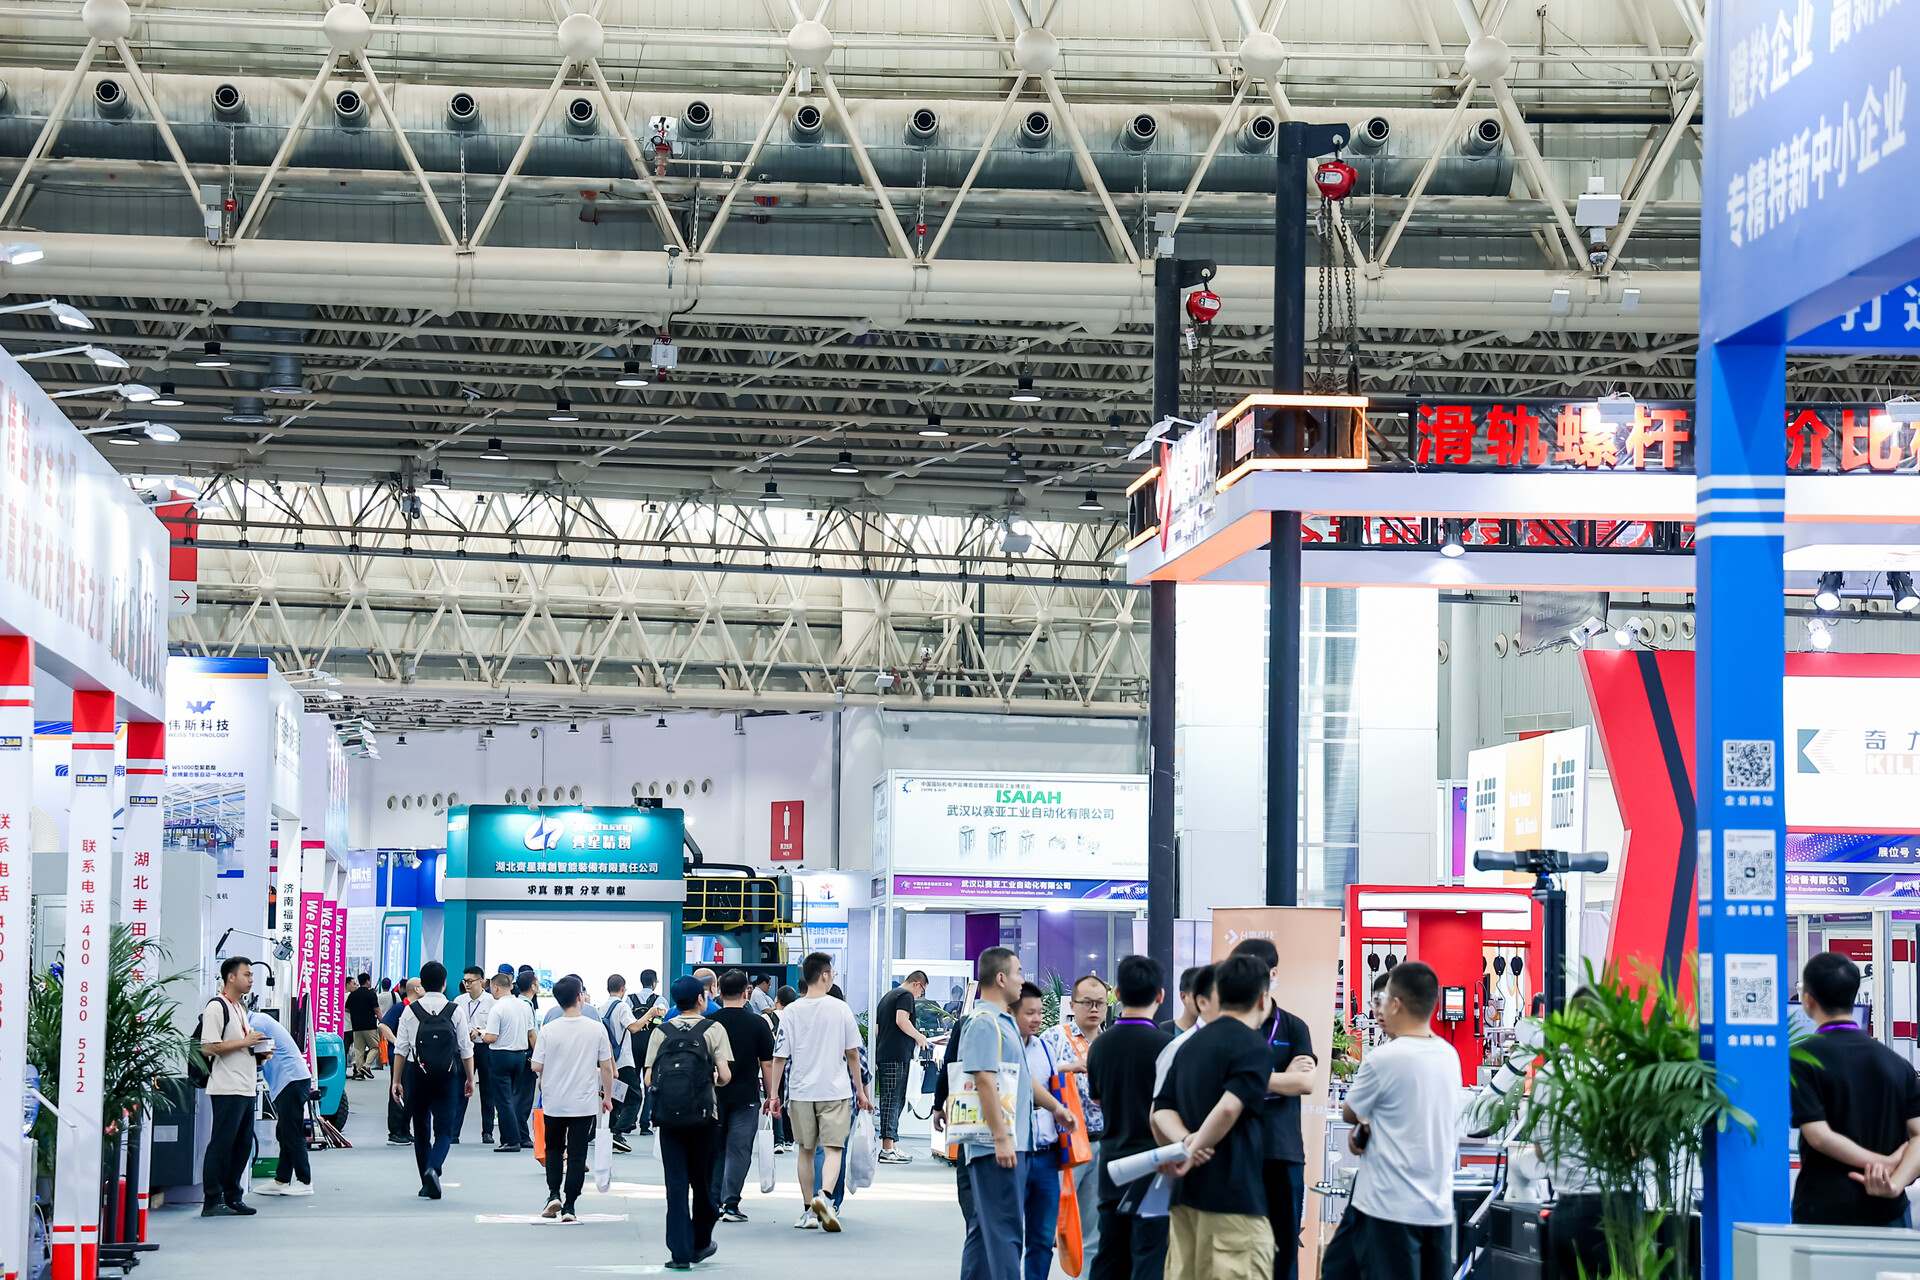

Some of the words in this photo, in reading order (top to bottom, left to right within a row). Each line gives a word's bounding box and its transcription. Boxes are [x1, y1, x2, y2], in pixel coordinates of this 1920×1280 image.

[1726, 65, 1906, 248] 专精特新中小企业
[1417, 404, 1691, 470] 滑轨螺杆
[1786, 408, 1920, 472] 价比
[168, 719, 230, 731] 伟斯科技
[946, 804, 1115, 820] 武汉以赛亚工业自动化有限公司
[996, 789, 1062, 804] ISAIAH
[80, 839, 97, 914] 联系电话
[306, 900, 318, 921] We
[322, 907, 333, 927] We
[335, 914, 344, 932] We
[81, 925, 92, 965] 400
[304, 923, 318, 961] keep
[320, 929, 333, 961] keep
[320, 963, 332, 985] the
[334, 964, 343, 985] the
[80, 981, 89, 1021] 880
[318, 987, 330, 1027] world
[76, 1038, 86, 1093] 5212
